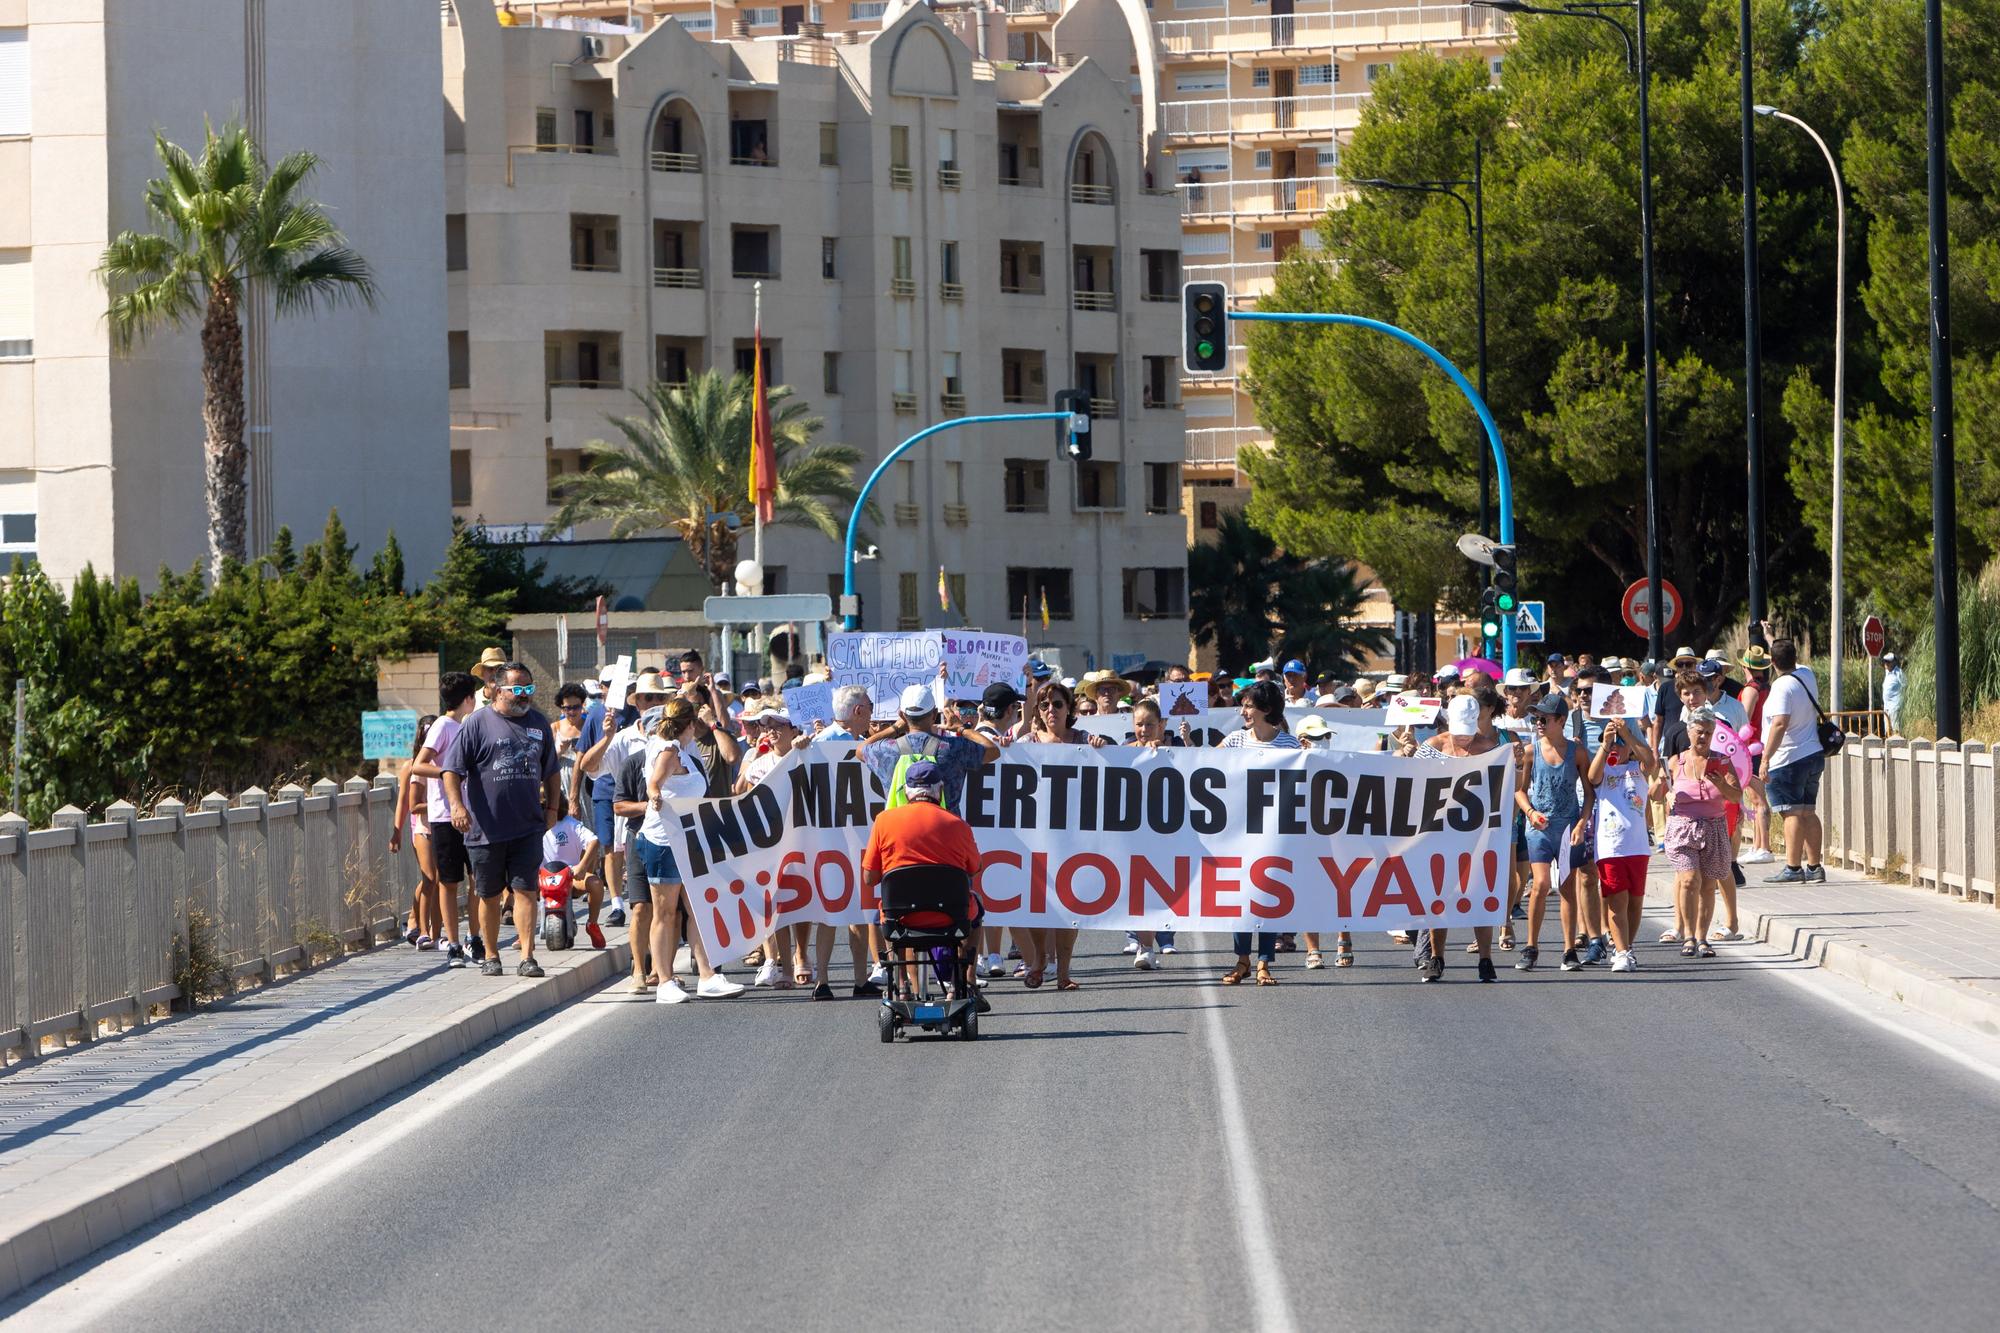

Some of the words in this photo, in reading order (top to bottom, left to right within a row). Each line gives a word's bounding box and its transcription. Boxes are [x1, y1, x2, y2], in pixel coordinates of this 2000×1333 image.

[830, 637, 940, 670] CAMPELLO
[1865, 631, 1883, 643] STOP
[800, 706, 825, 721] SOS
[680, 784, 784, 878] ¡NO
[963, 763, 1227, 835] ERTIDOS
[1246, 765, 1506, 837] FECALES!
[704, 849, 1295, 949] ¡¡¡SOLCIONES
[1318, 849, 1500, 918] YA!!!
